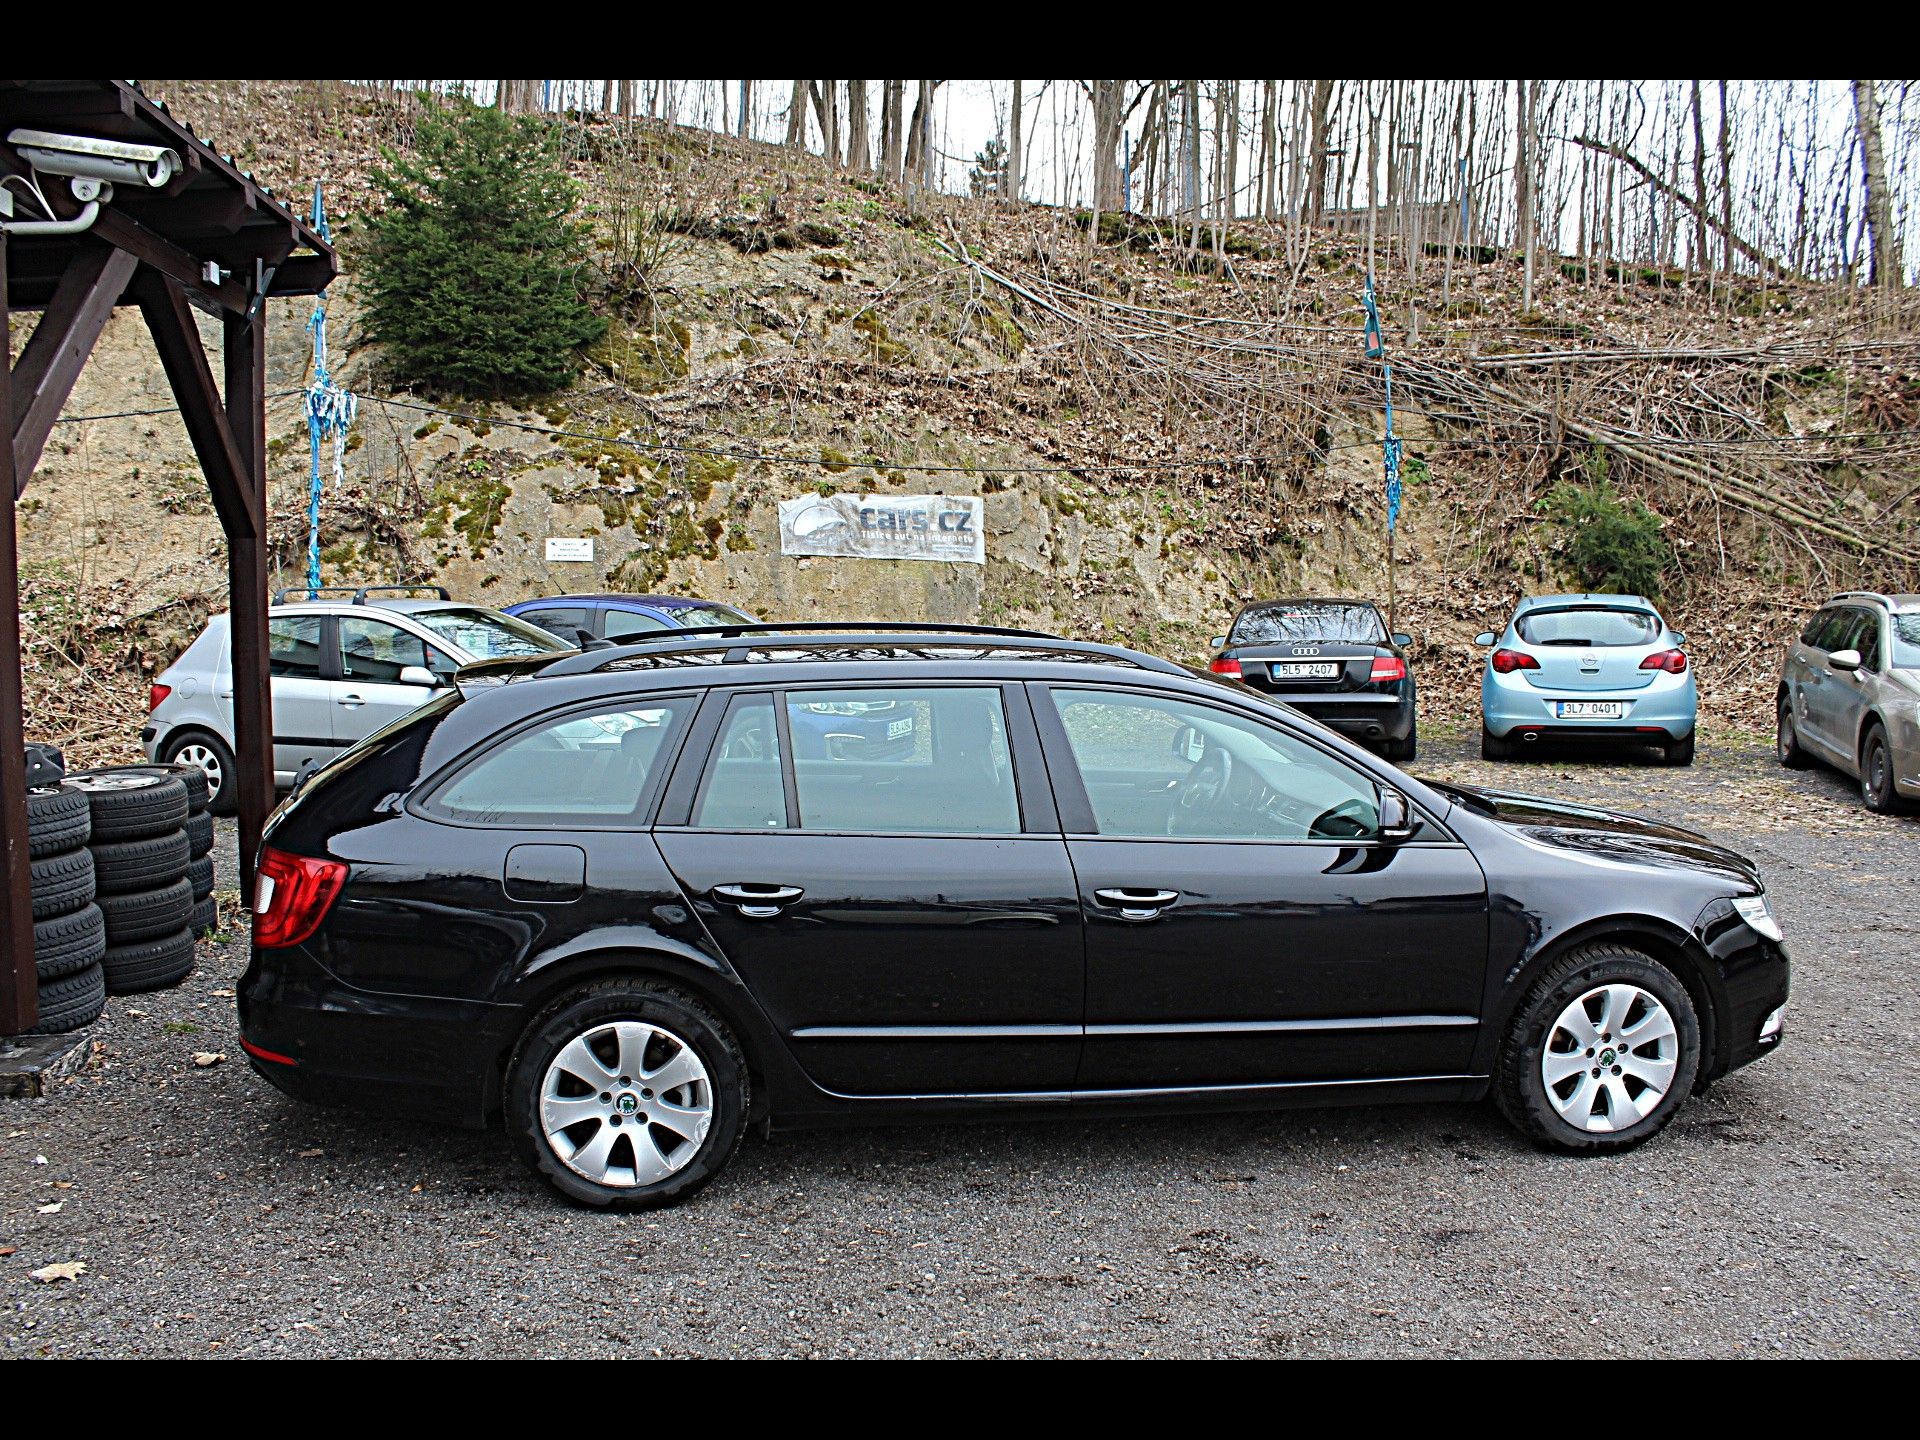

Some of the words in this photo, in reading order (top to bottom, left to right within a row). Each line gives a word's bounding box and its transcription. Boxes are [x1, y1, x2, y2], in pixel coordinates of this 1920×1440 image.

[894, 532, 910, 541] aut
[928, 534, 974, 543] internetu
[1282, 664, 1301, 675] 5L5
[1308, 664, 1333, 675] 2407
[1566, 703, 1585, 714] 3L7
[1591, 703, 1617, 714] 0401
